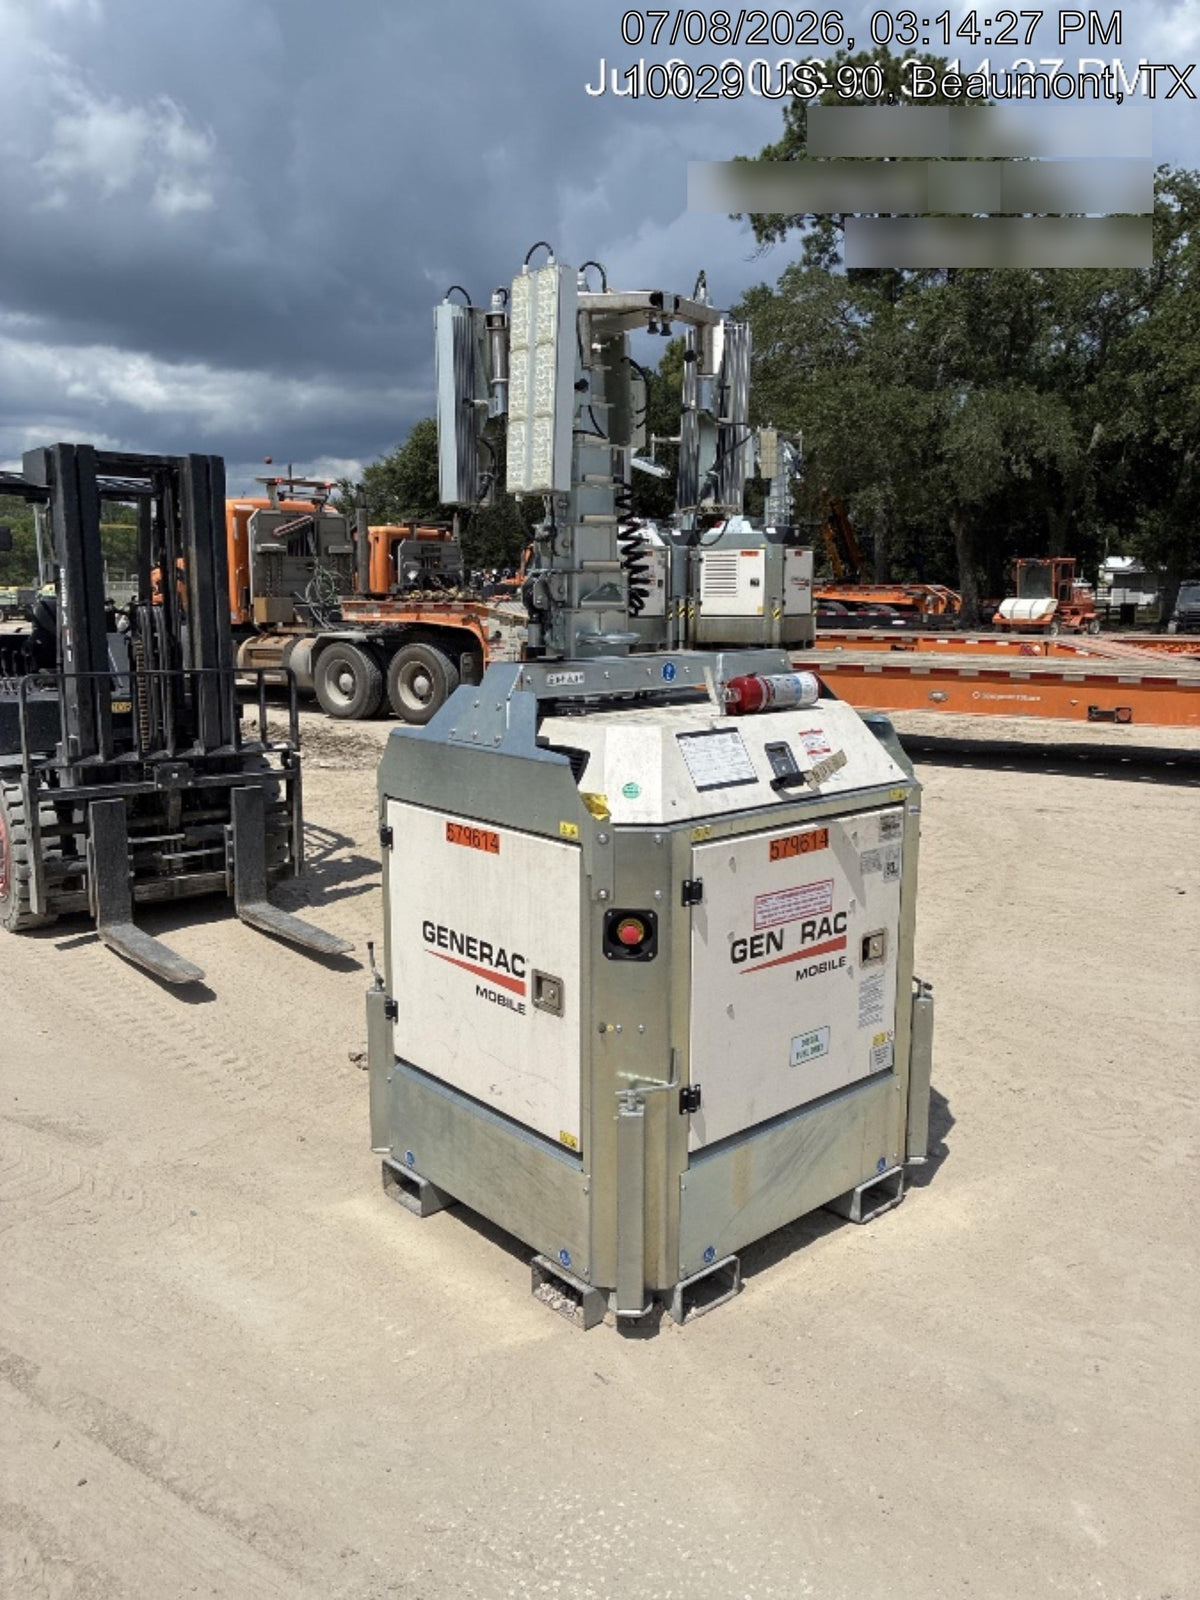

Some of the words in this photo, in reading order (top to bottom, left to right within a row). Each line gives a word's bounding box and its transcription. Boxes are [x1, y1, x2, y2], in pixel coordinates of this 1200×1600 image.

[447, 823, 500, 853] 579614
[769, 828, 829, 860] 579614
[422, 919, 526, 978] GENERAC
[795, 955, 848, 981] MOBILE
[475, 984, 527, 1016] MOBILE
